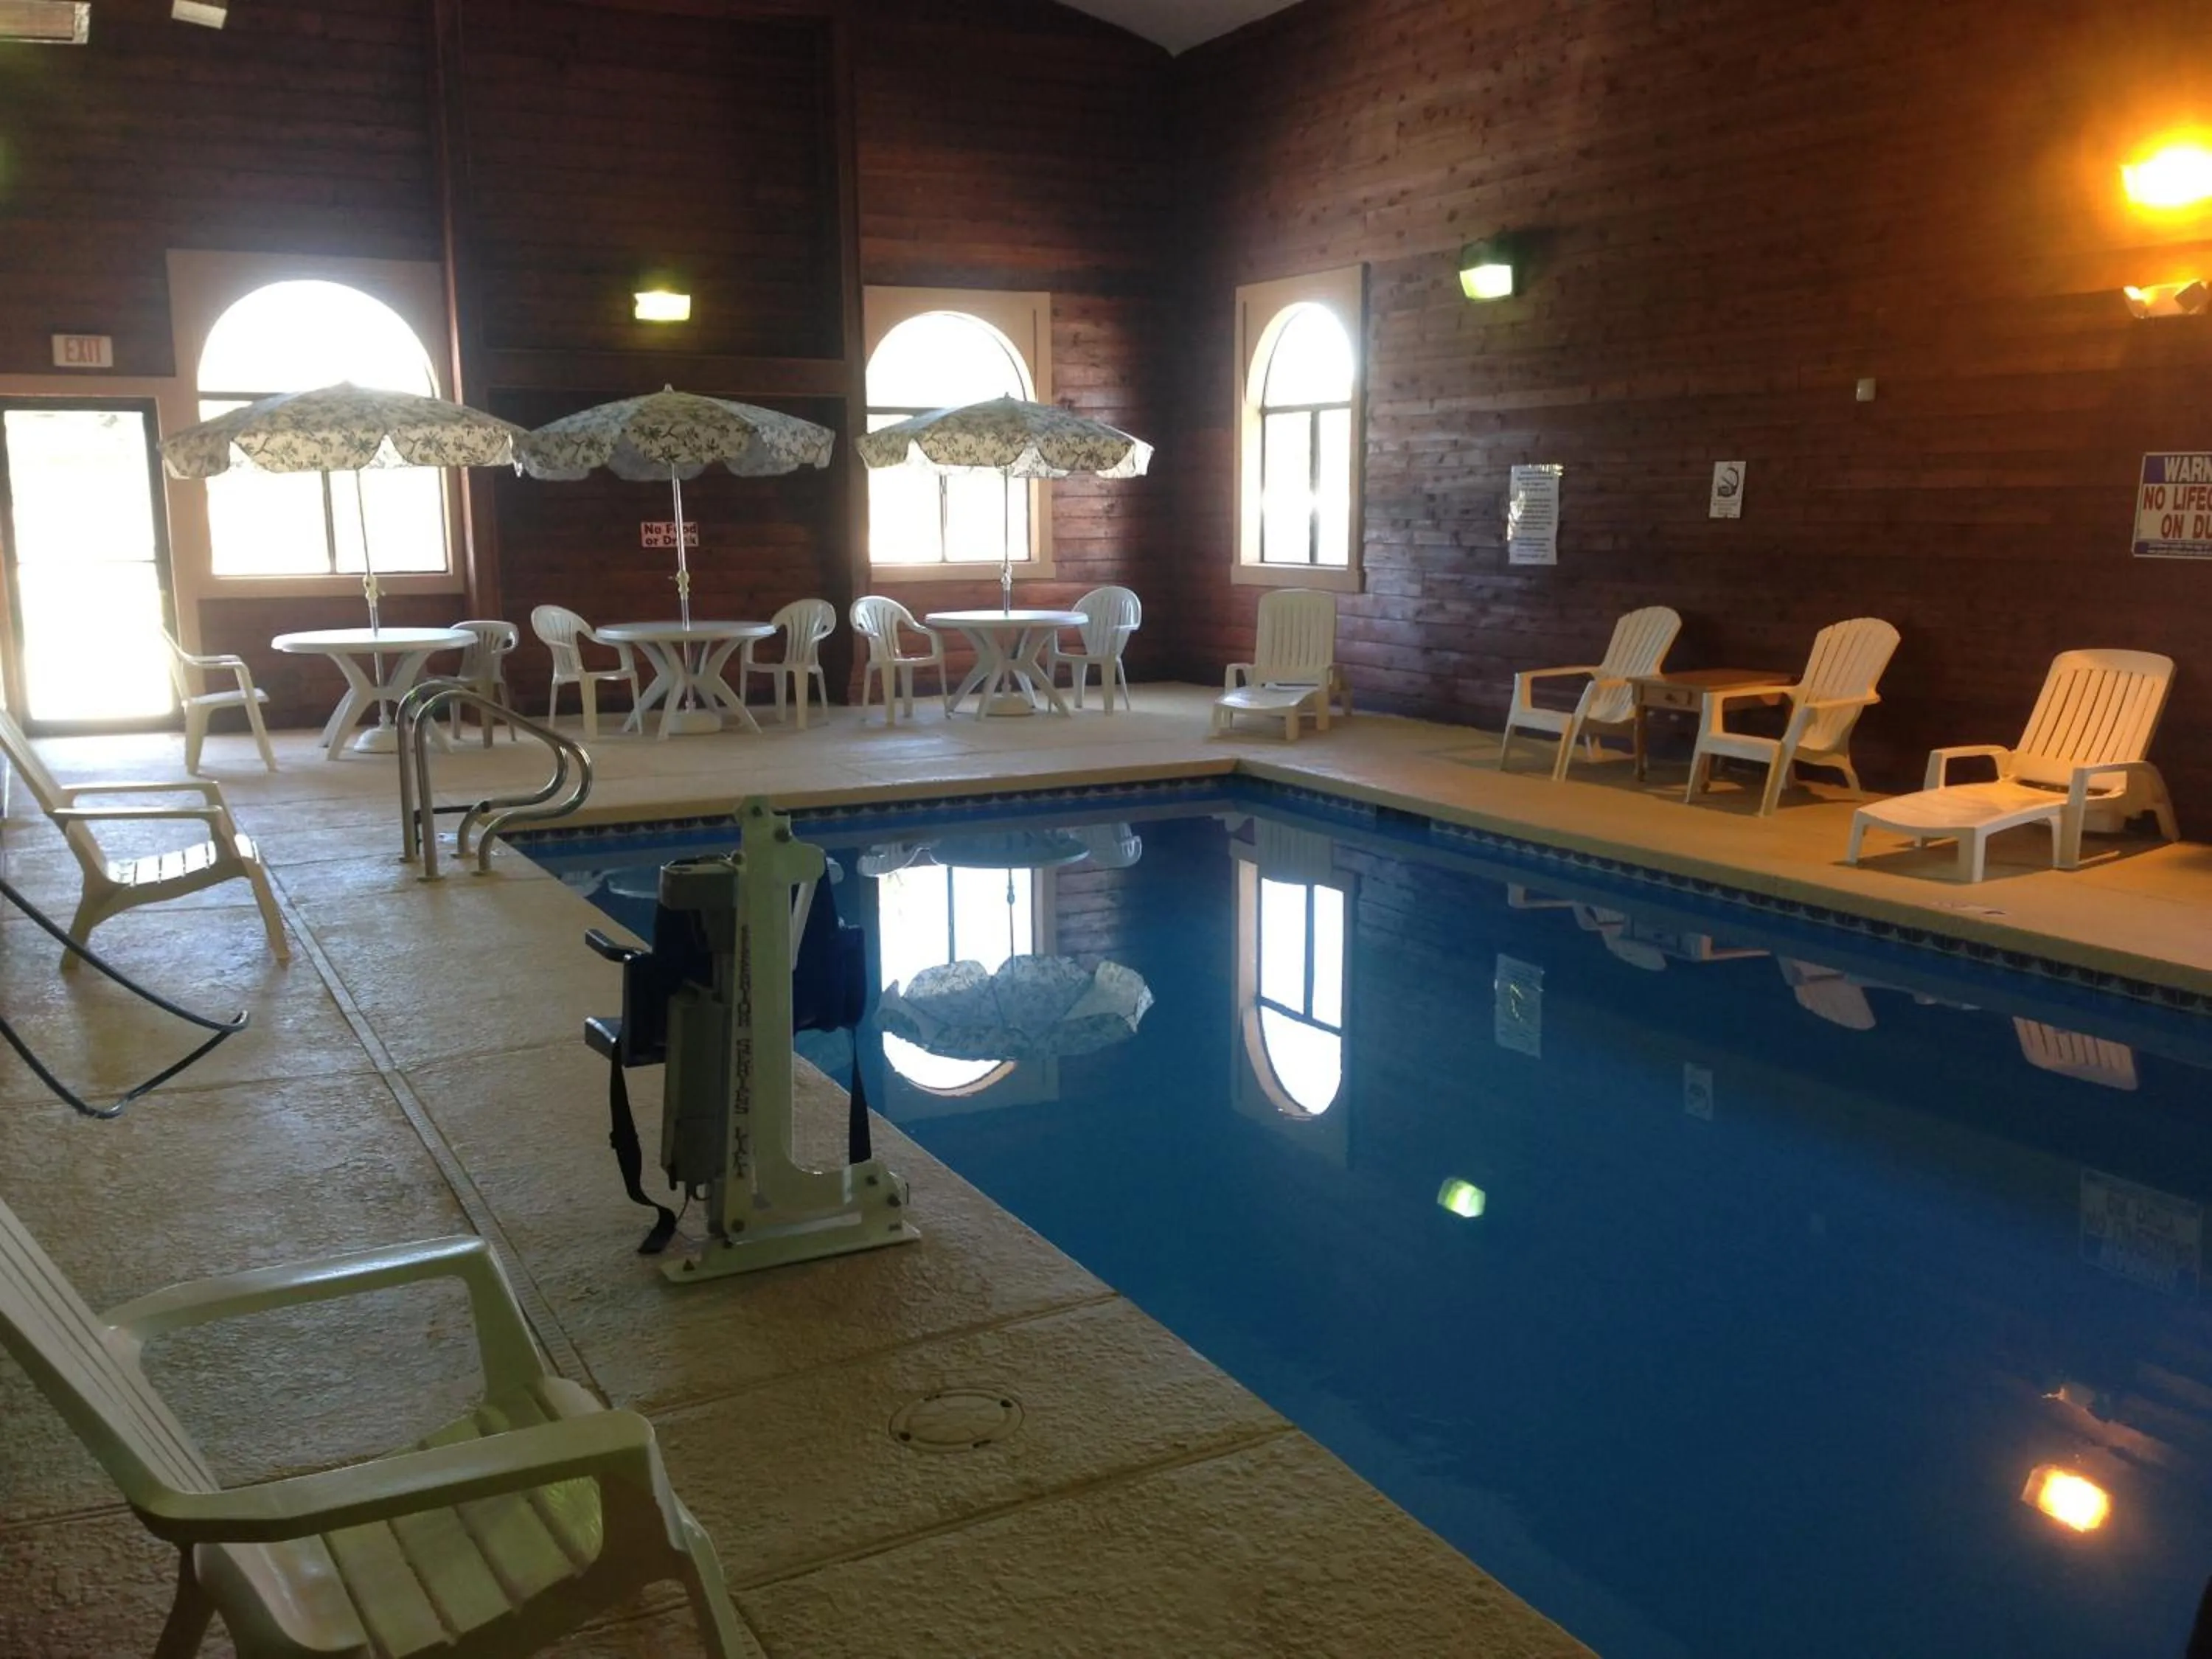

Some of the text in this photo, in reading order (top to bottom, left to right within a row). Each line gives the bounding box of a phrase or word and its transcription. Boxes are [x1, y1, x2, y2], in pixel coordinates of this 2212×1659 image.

[64, 336, 102, 364] EXIT
[2143, 486, 2166, 511] NO
[644, 524, 661, 535] No
[2161, 514, 2184, 539] ON
[645, 538, 658, 546] or
